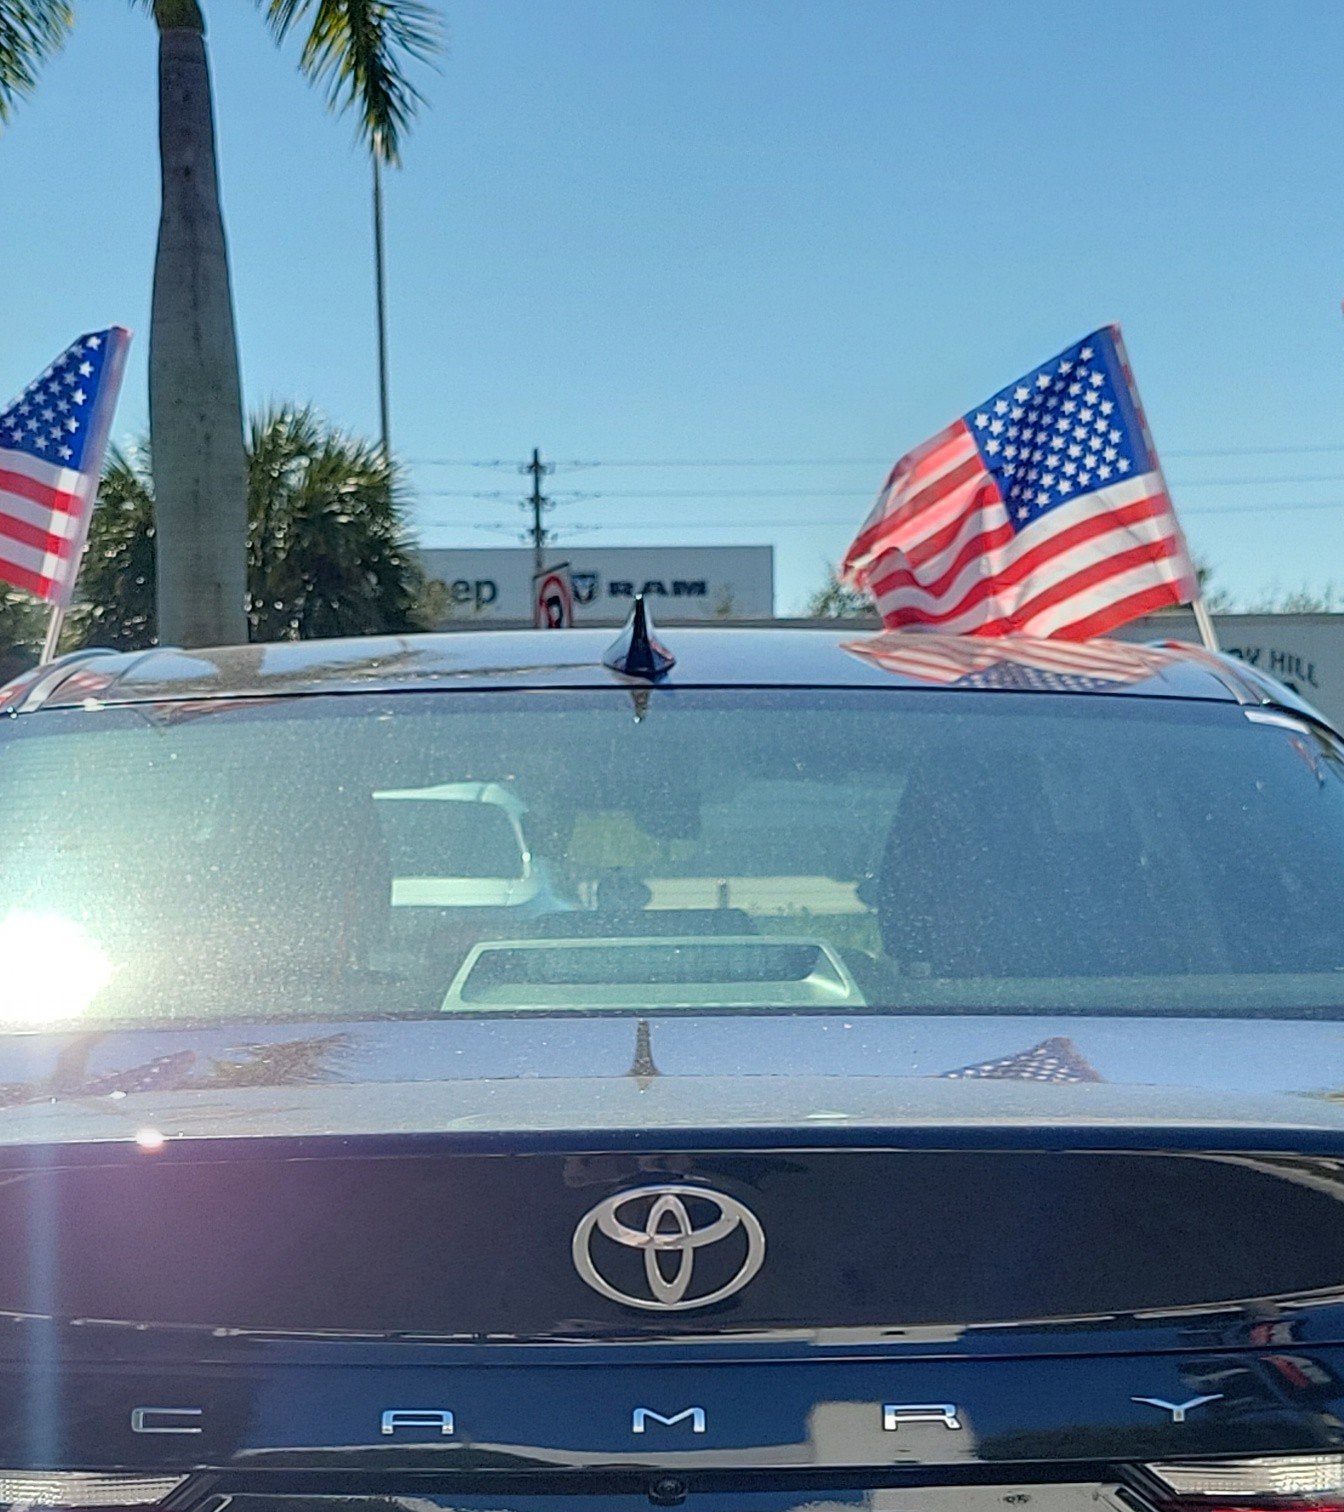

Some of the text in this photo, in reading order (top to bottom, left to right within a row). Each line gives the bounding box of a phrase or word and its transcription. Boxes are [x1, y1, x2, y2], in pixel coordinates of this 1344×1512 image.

[427, 579, 497, 611] eep
[609, 579, 708, 597] RAM
[131, 1393, 1224, 1434] CAMRY
